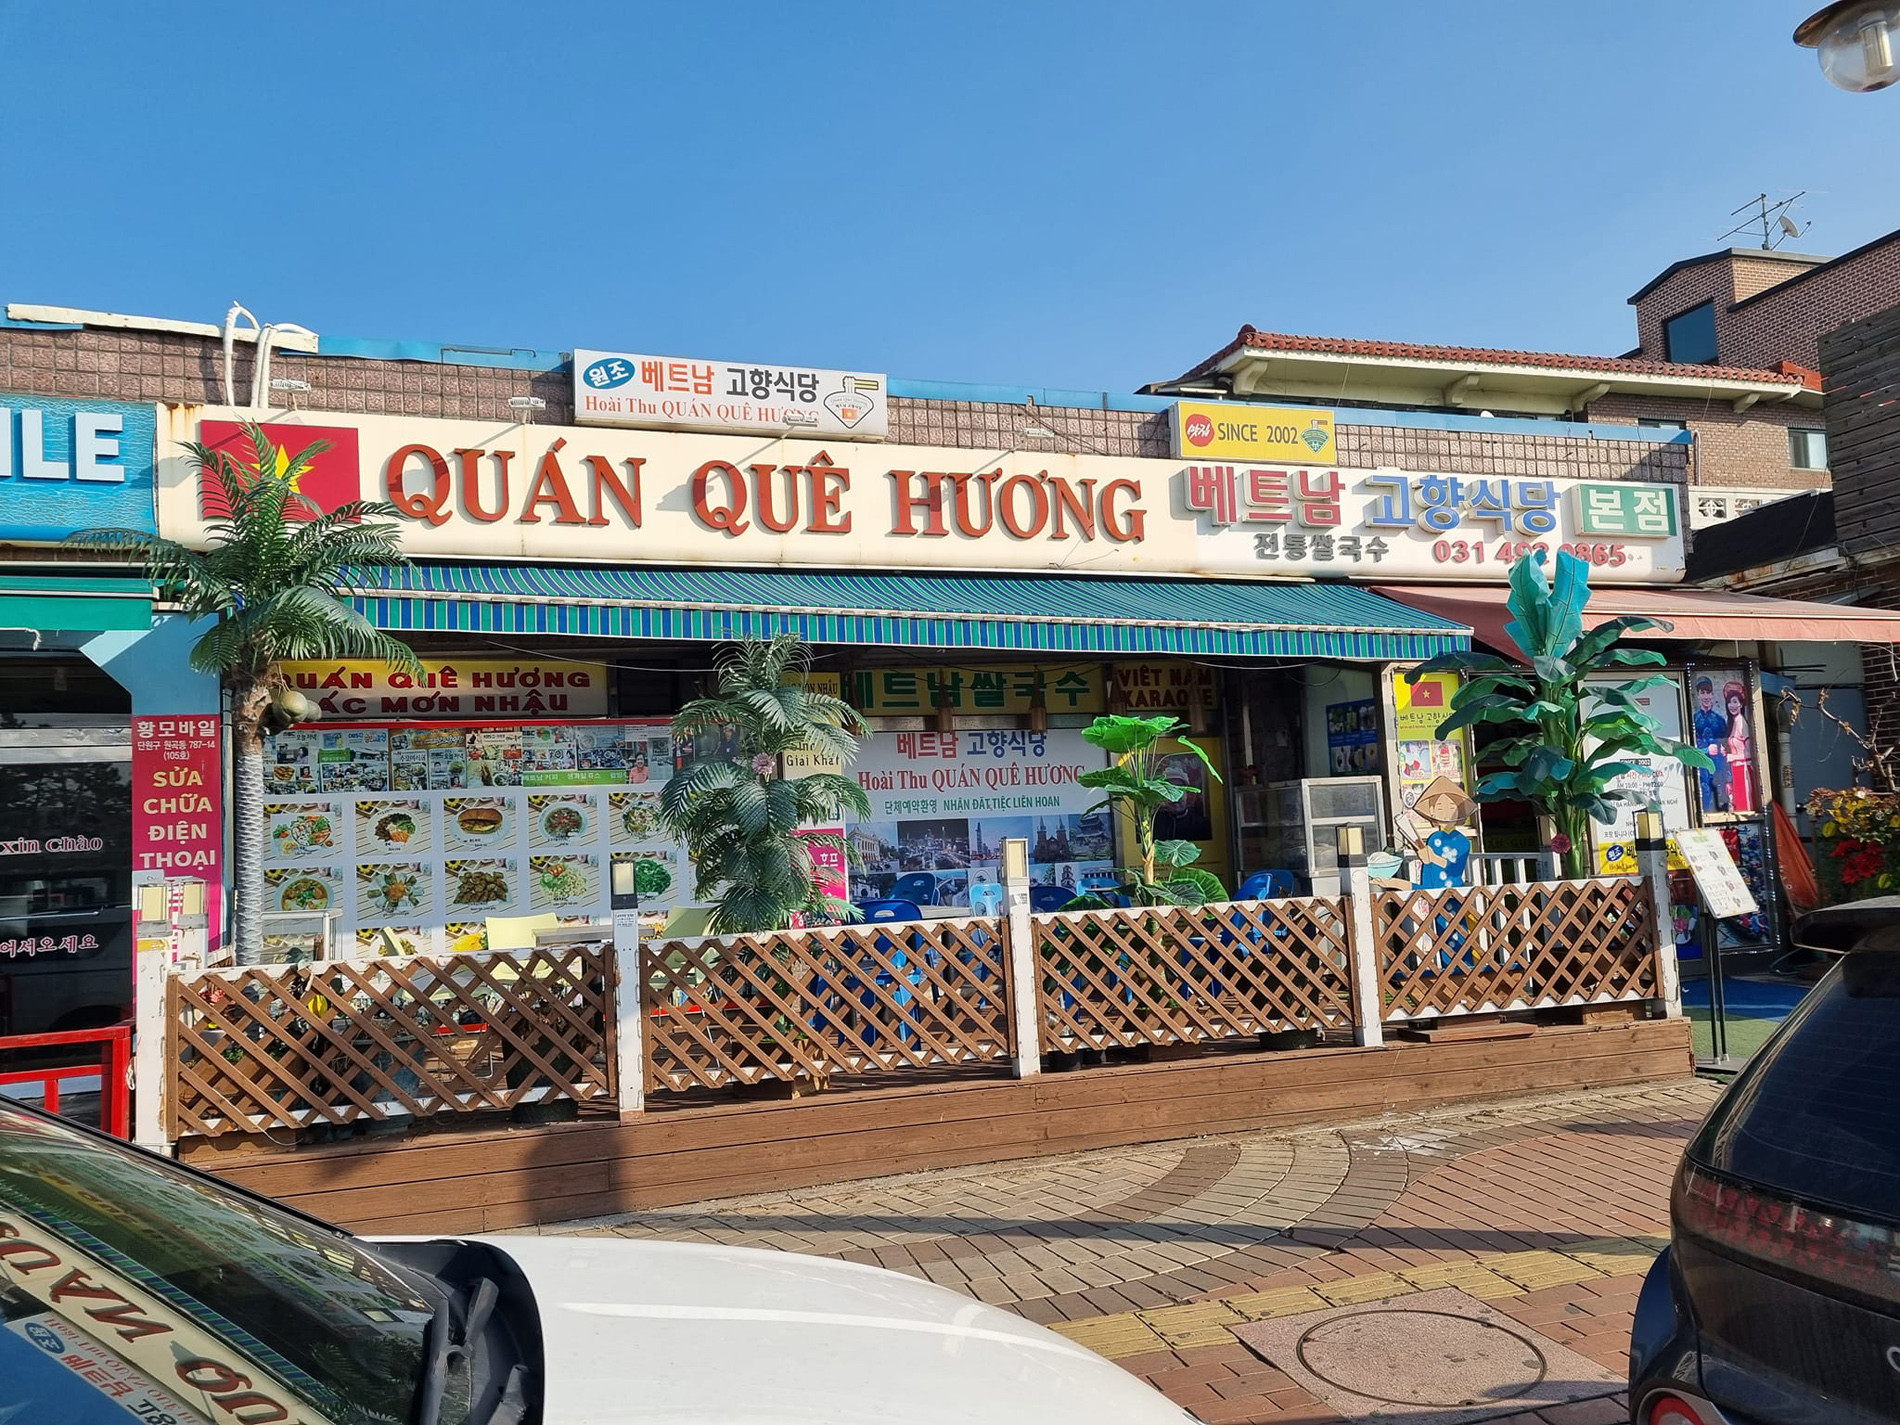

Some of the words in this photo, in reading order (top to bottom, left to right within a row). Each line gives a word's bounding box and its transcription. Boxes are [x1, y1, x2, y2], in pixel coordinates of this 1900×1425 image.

[588, 361, 629, 388] 원조
[641, 361, 715, 395] 베트남
[726, 368, 819, 403] 고향식당
[586, 395, 621, 413] Hoài
[626, 398, 657, 415] Thu
[662, 398, 712, 419] QUÁN
[717, 402, 753, 422] QUÊ
[1217, 423, 1258, 442] SINCE
[1266, 425, 1299, 444] 2002
[387, 437, 647, 527] QUÁN
[691, 450, 852, 536] QUÊ
[888, 467, 1147, 542] HƯƠNG
[1188, 466, 1346, 526] 베트남
[1372, 474, 1562, 534] 고향식당
[1588, 489, 1669, 531] 본점
[1254, 533, 1389, 562] 전통쌀국수
[1434, 540, 1484, 563] 031
[472, 667, 590, 688] HƯƠNG
[318, 690, 367, 713] ÁC
[474, 689, 568, 715] NHẬU
[1121, 688, 1213, 707] KARAOE
[1400, 713, 1423, 724] 베트남
[137, 721, 215, 738] 황모바일
[137, 741, 161, 751] 단원구
[164, 740, 187, 750] 원곡동
[189, 740, 215, 749] 787-14
[896, 730, 959, 759] 베트남
[966, 731, 1047, 758] 고향식당
[163, 751, 190, 760] (105호)
[153, 766, 203, 788] SỬA
[857, 770, 894, 791] Hoài
[897, 770, 928, 790] Thu
[931, 763, 980, 792] QUÁN
[985, 762, 1020, 790] QUÊ
[143, 793, 213, 814] CHỮA
[885, 799, 937, 815] 단체예약환영
[943, 797, 970, 814] NHẬN
[992, 795, 1011, 811] TIỆC
[1013, 795, 1033, 809] LIÊN
[1035, 796, 1060, 807] HOAN
[147, 820, 207, 845] ĐIỆN
[0, 837, 42, 856] xin
[45, 835, 103, 852] chào
[139, 850, 215, 871] THOẠI
[820, 853, 838, 867] 호프
[0, 935, 99, 958] 어서오세요
